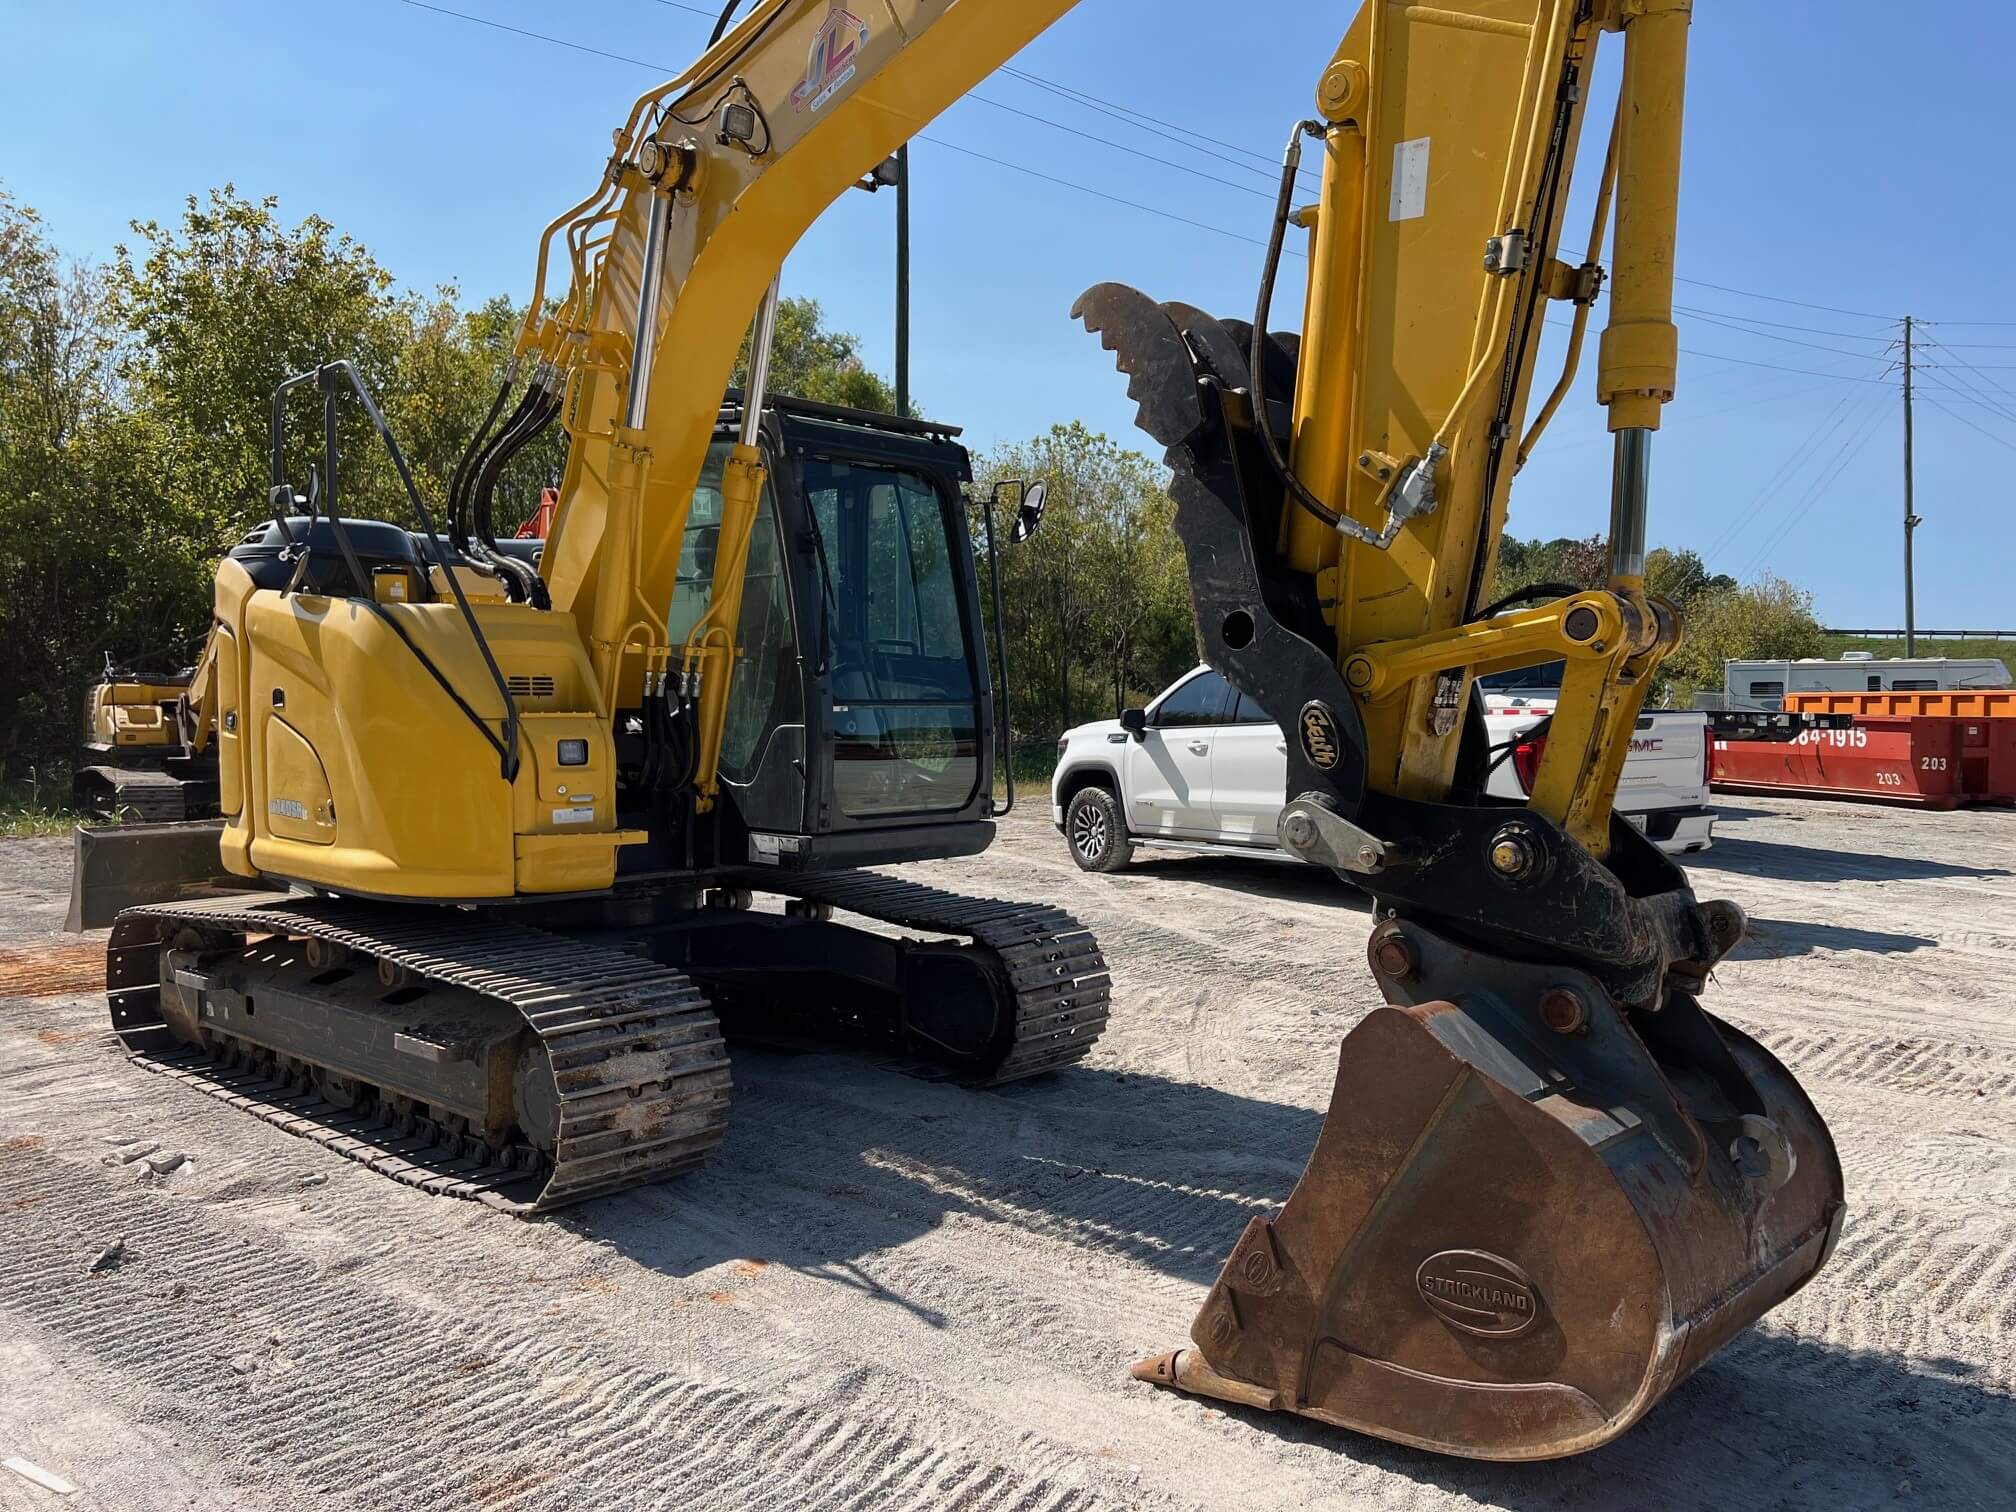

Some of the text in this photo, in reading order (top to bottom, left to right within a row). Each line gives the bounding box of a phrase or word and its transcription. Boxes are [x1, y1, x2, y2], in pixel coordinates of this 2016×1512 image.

[1921, 756, 1947, 771] 203
[1876, 772, 1901, 786] 203
[1424, 1275, 1529, 1310] STRICKLAND
